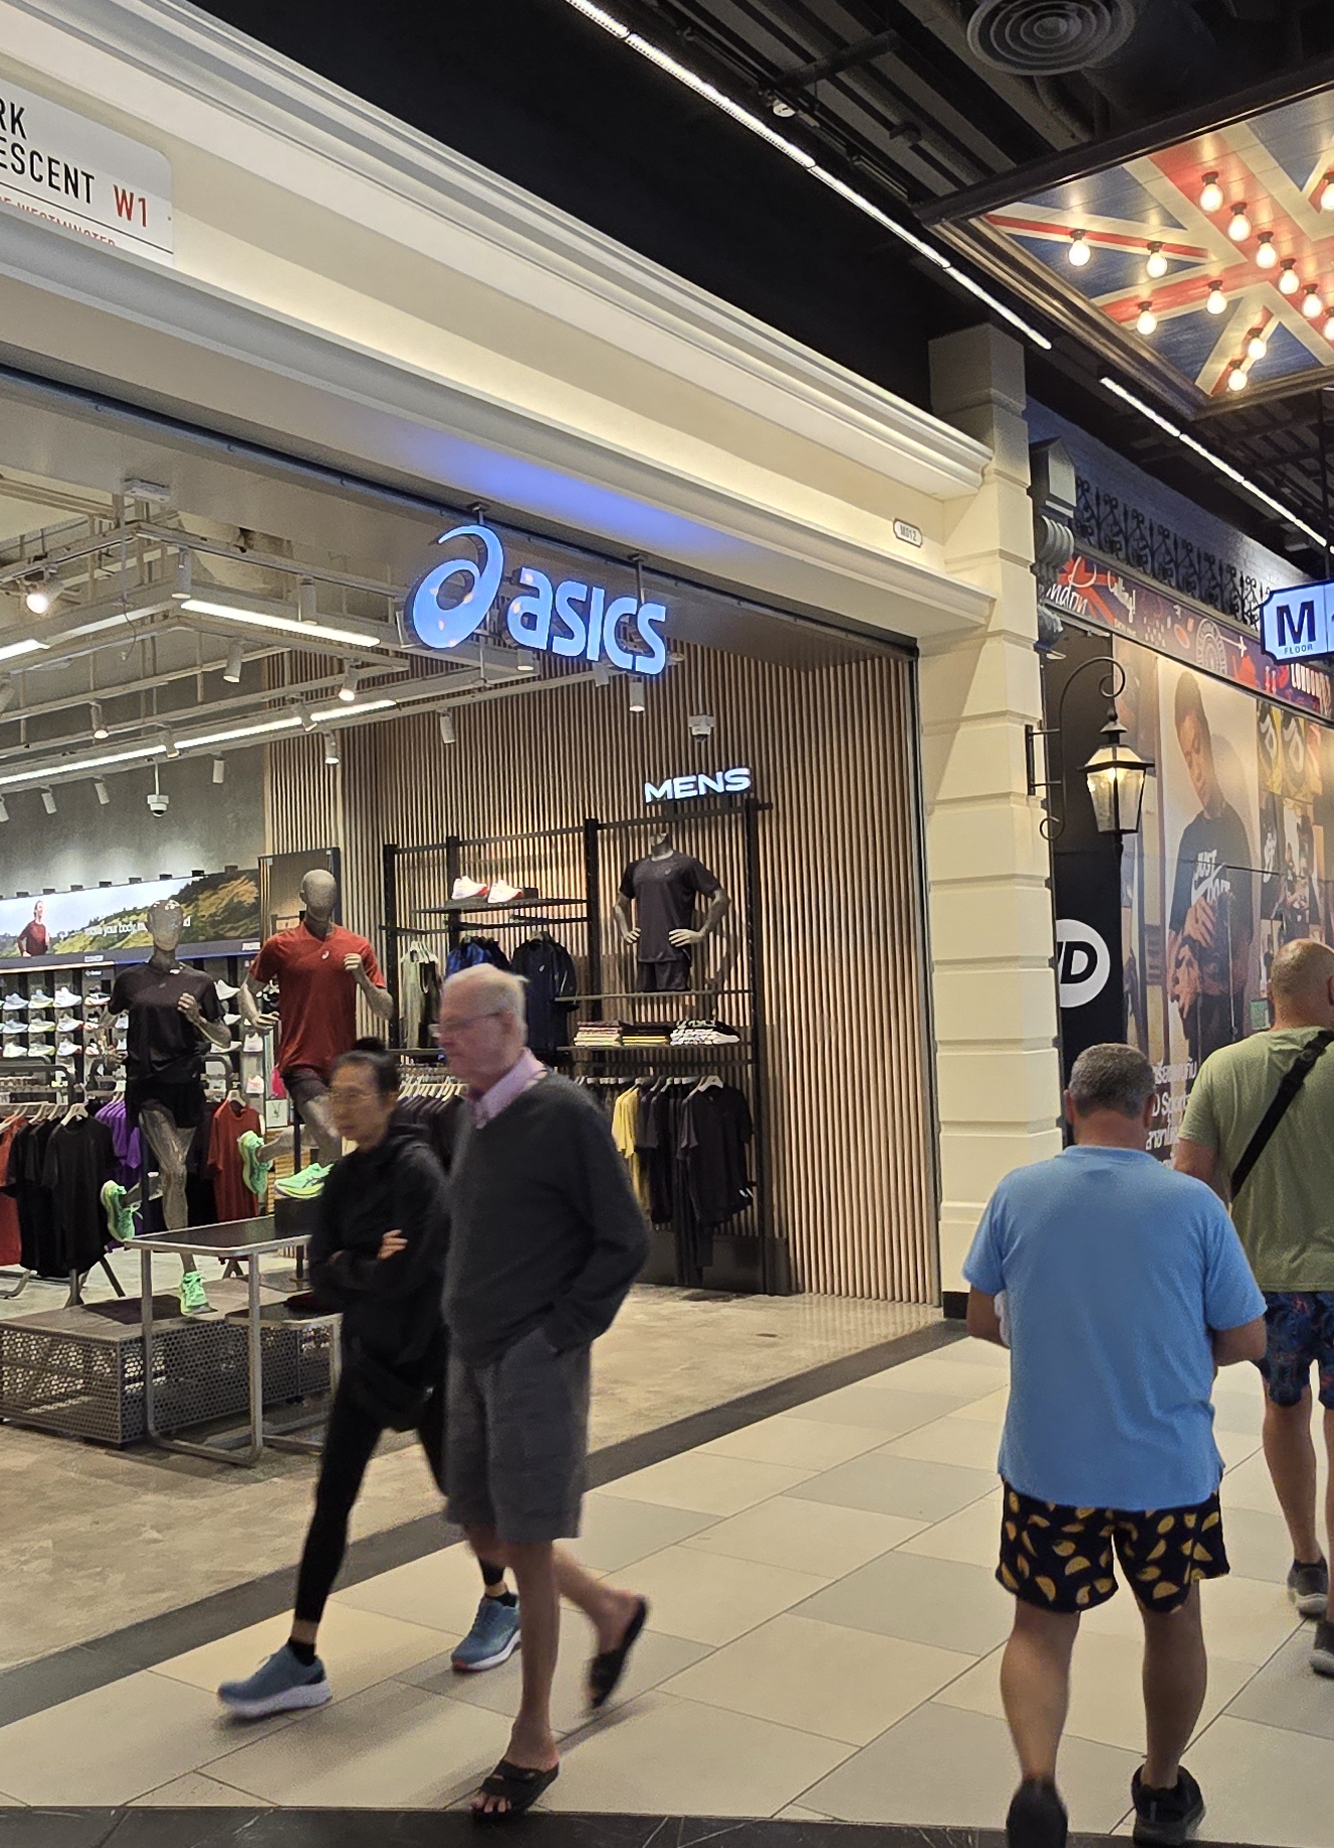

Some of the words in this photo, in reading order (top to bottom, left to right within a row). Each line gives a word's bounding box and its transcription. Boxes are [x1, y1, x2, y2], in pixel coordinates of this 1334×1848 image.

[113, 184, 148, 228] W1
[1276, 600, 1316, 647] M
[1284, 643, 1313, 655] FLOOR
[644, 767, 751, 804] MENS
[1057, 940, 1098, 984] D
